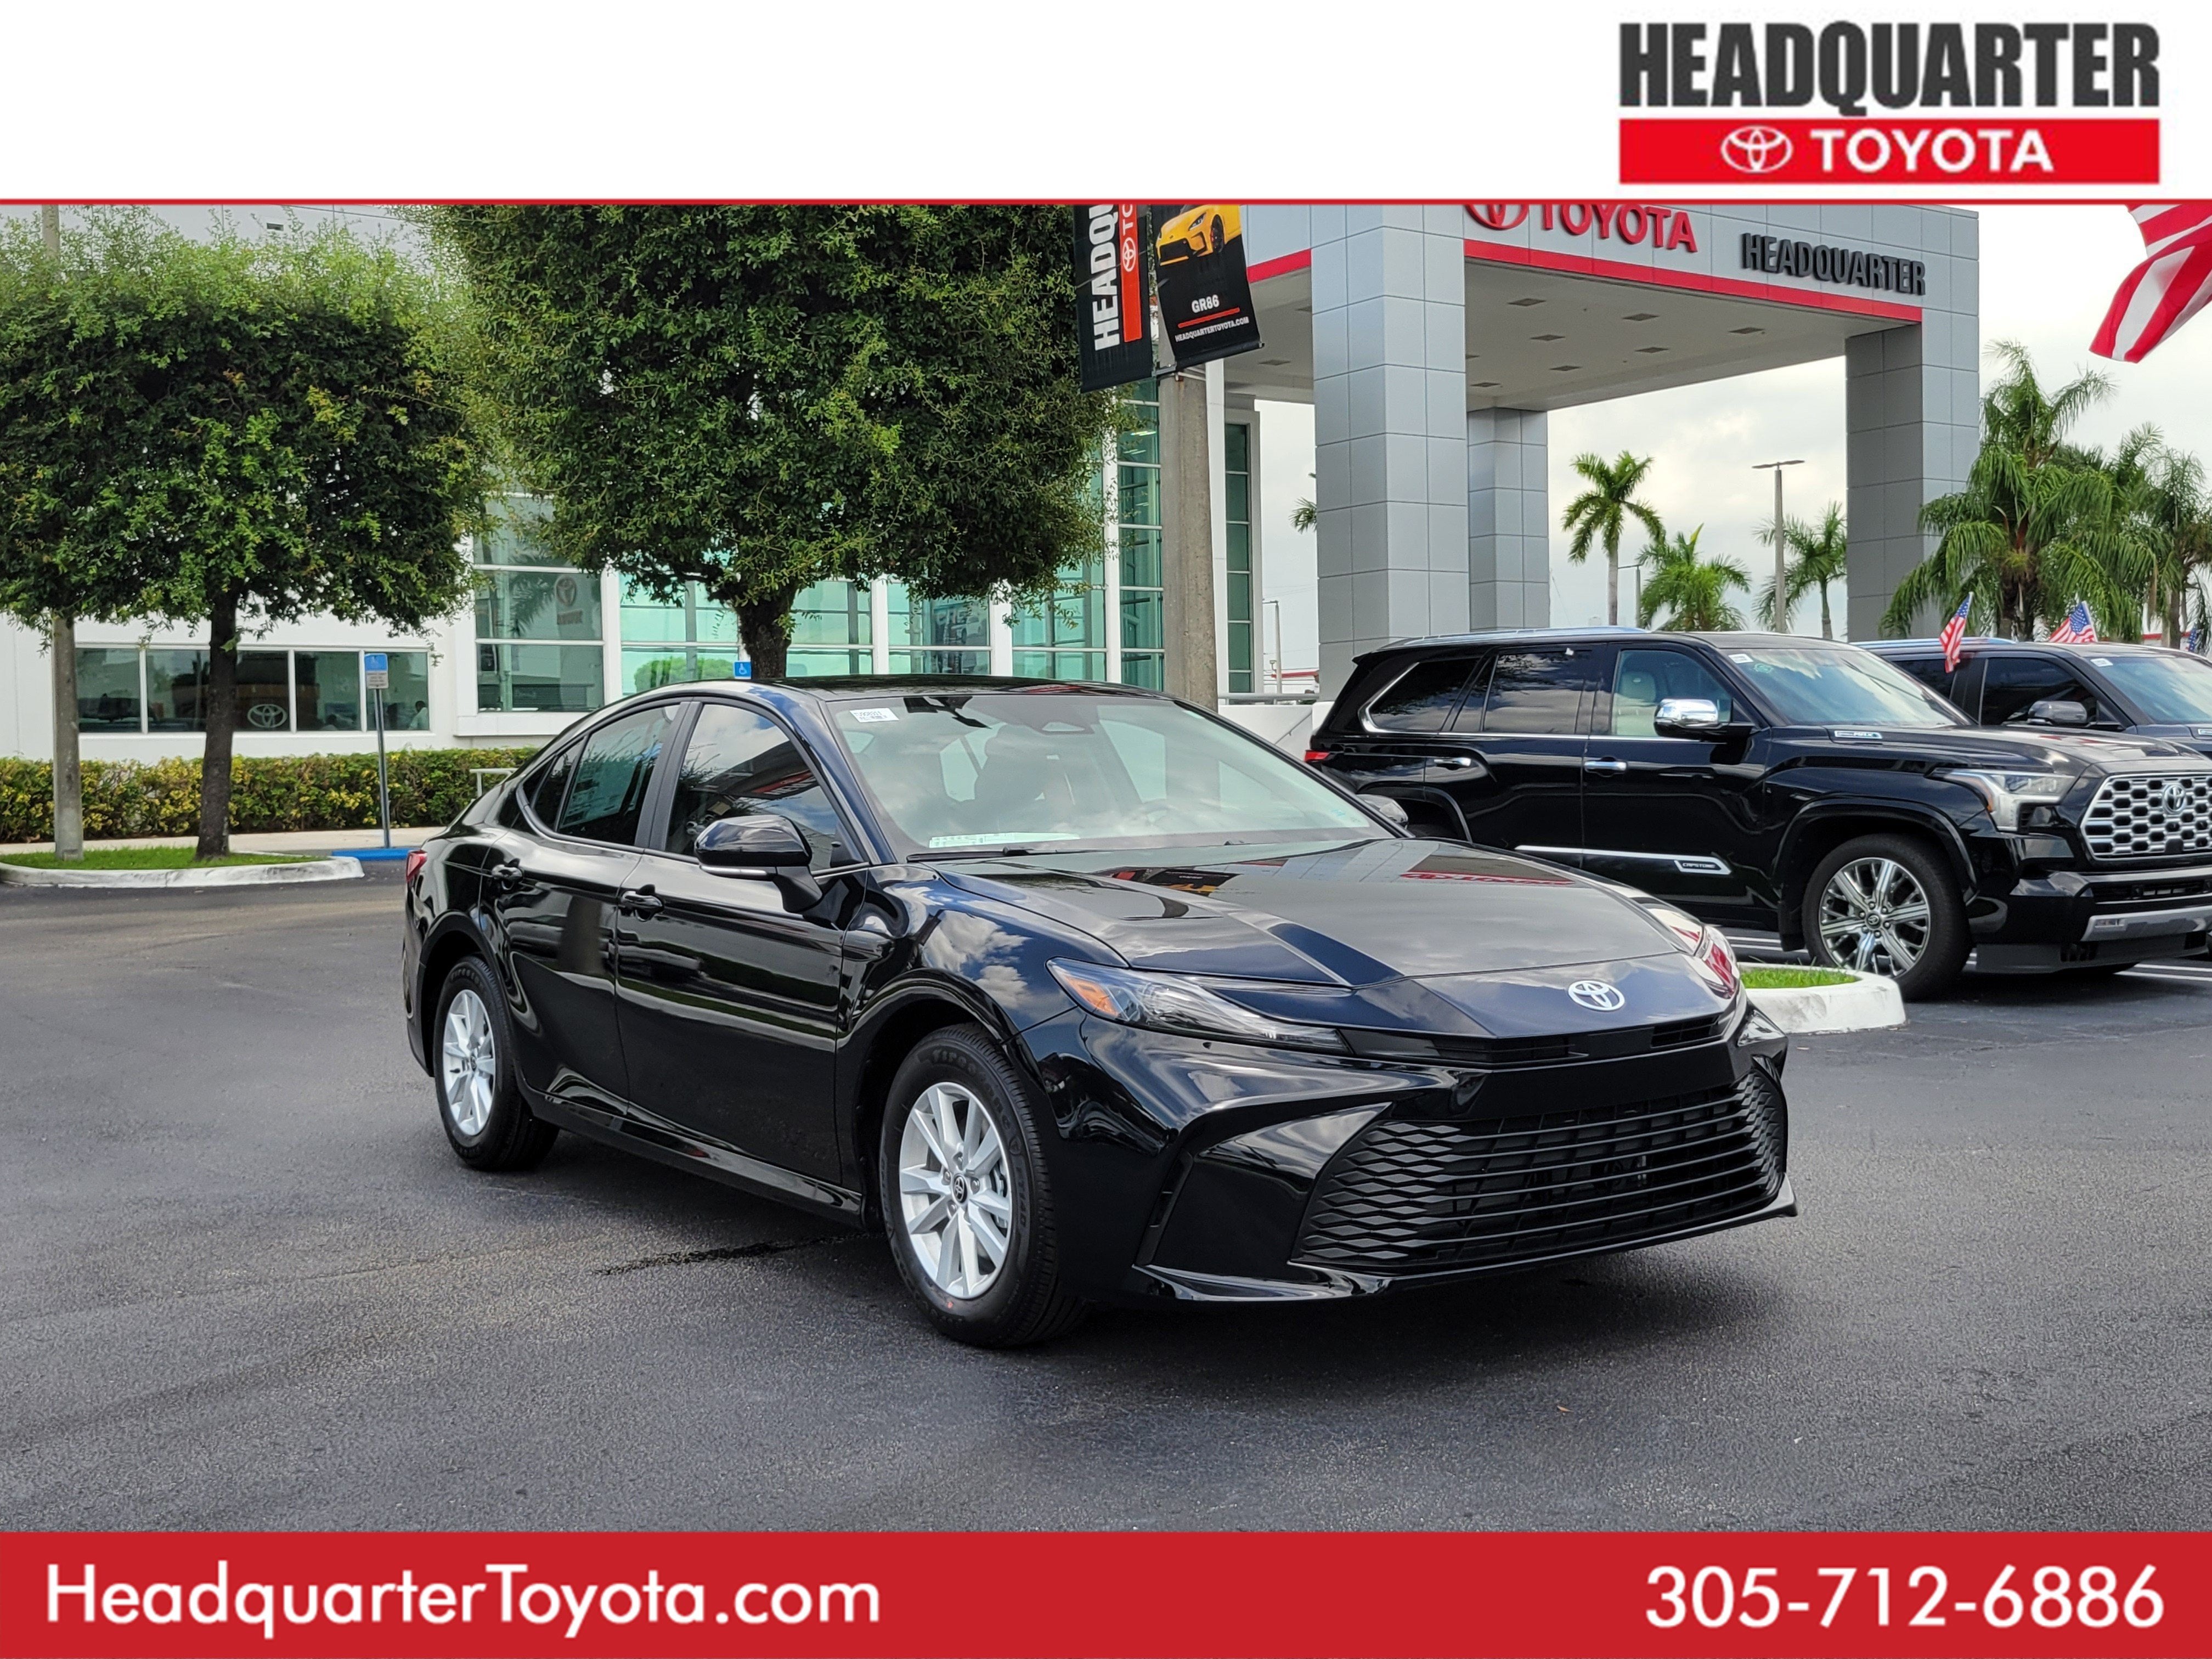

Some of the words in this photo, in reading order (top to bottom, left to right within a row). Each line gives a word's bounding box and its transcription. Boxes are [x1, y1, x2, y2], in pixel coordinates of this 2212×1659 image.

[1741, 233, 1926, 296] HEADQUARTER
[1191, 294, 1220, 313] GR86
[1175, 316, 1249, 342] HEADQUARTERTOYOTA.COM
